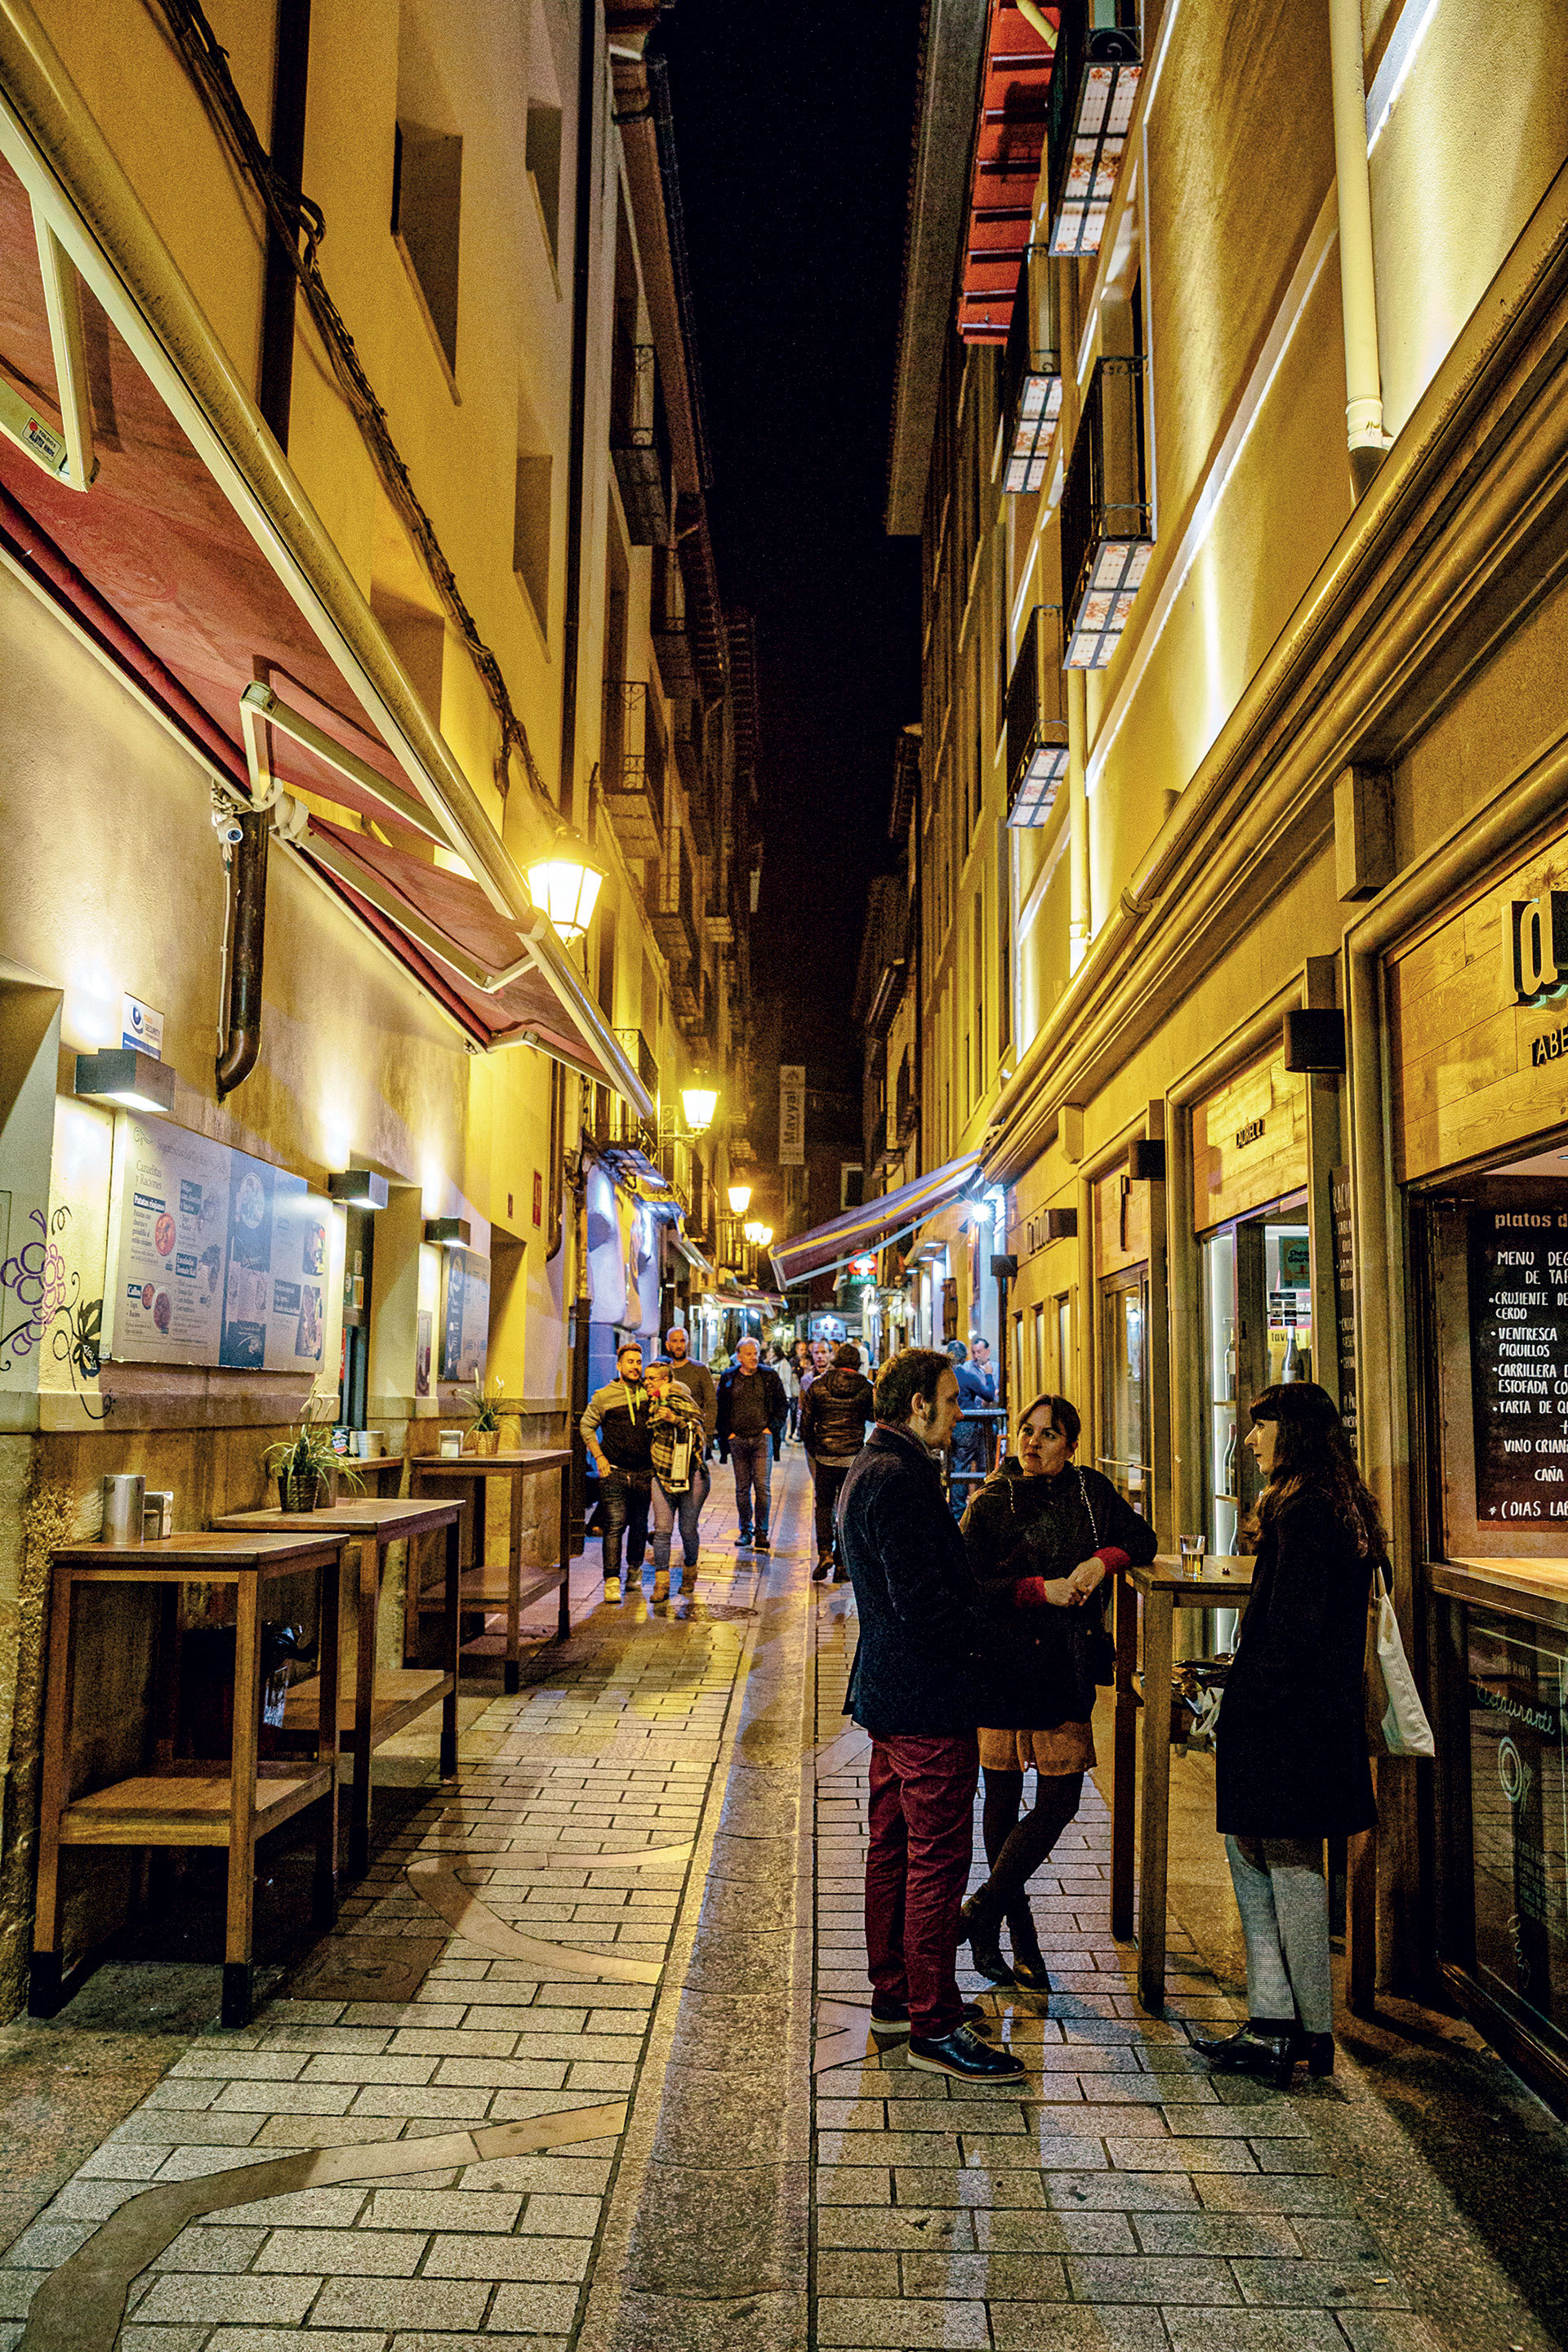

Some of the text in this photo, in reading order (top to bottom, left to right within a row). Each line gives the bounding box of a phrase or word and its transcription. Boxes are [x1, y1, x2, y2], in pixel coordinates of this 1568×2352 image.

[1494, 1213, 1552, 1229] platos
[1497, 1251, 1535, 1266] MENU
[1525, 1270, 1540, 1285] DE
[1494, 1292, 1548, 1305] CRUJIENTE
[1495, 1307, 1527, 1320] CERDO
[1498, 1327, 1557, 1341] VENTRESCA
[1499, 1343, 1550, 1357] PIQUILLOS
[1498, 1363, 1557, 1378] CARRILLERA
[1498, 1379, 1548, 1395] ESTOFADA
[1499, 1400, 1531, 1414] TARTA
[1539, 1400, 1552, 1414] DE
[1503, 1439, 1531, 1453] VINO
[1535, 1465, 1564, 1482] CAÑA
